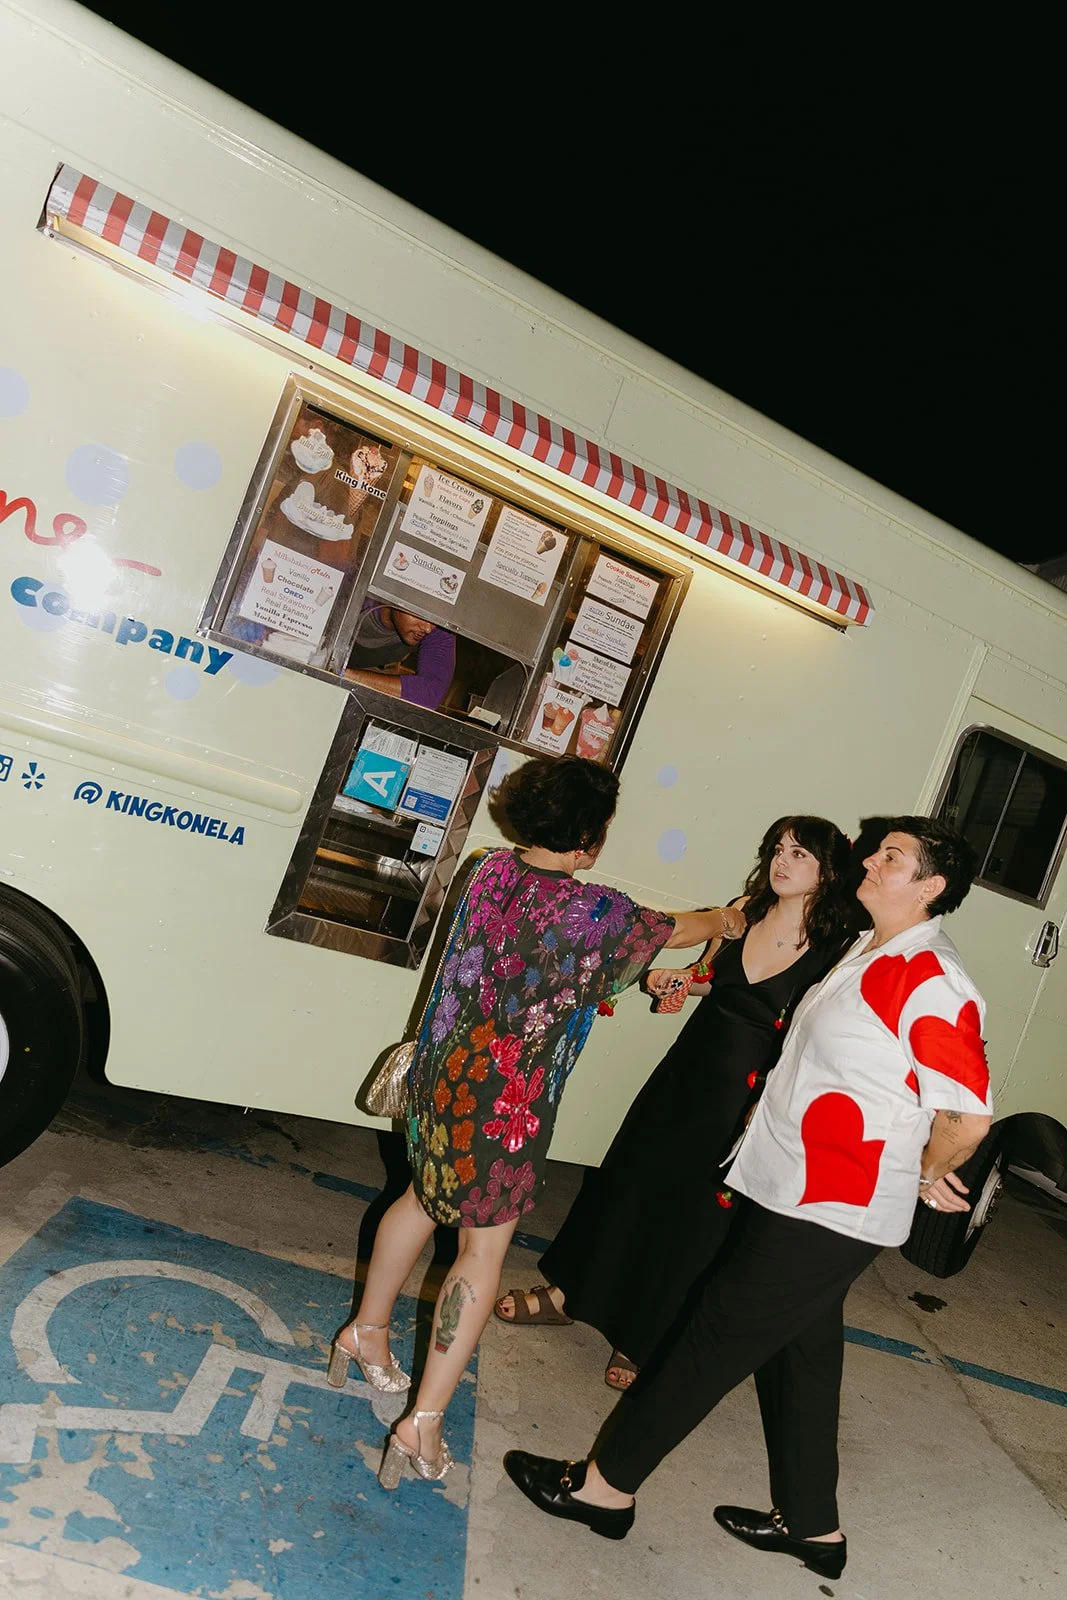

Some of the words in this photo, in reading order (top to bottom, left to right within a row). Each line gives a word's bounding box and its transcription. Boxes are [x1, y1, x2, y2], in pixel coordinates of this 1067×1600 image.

[335, 470, 358, 490] King
[359, 480, 387, 499] Kone
[438, 475, 450, 484] Ice
[451, 481, 475, 497] Cream
[438, 494, 463, 510] Flavors
[429, 513, 459, 531] Toppings
[288, 568, 310, 582] Vanilla
[412, 554, 445, 574] Sundaes
[605, 561, 625, 575] Cookie
[624, 571, 651, 588] Sandwich
[277, 574, 314, 594] Chocolate
[261, 586, 276, 597] Real
[278, 593, 316, 614] Strawberry
[265, 597, 280, 608] Real
[282, 605, 308, 619] Banana
[253, 611, 276, 624] Mocha
[278, 621, 309, 637] Espresso
[255, 602, 280, 616] Vanilla
[282, 614, 312, 630] Espresso
[605, 612, 635, 631] Sundae
[583, 624, 605, 638] Cookie
[605, 634, 626, 647] Sundae
[556, 692, 574, 703] Floats
[362, 771, 397, 799] A
